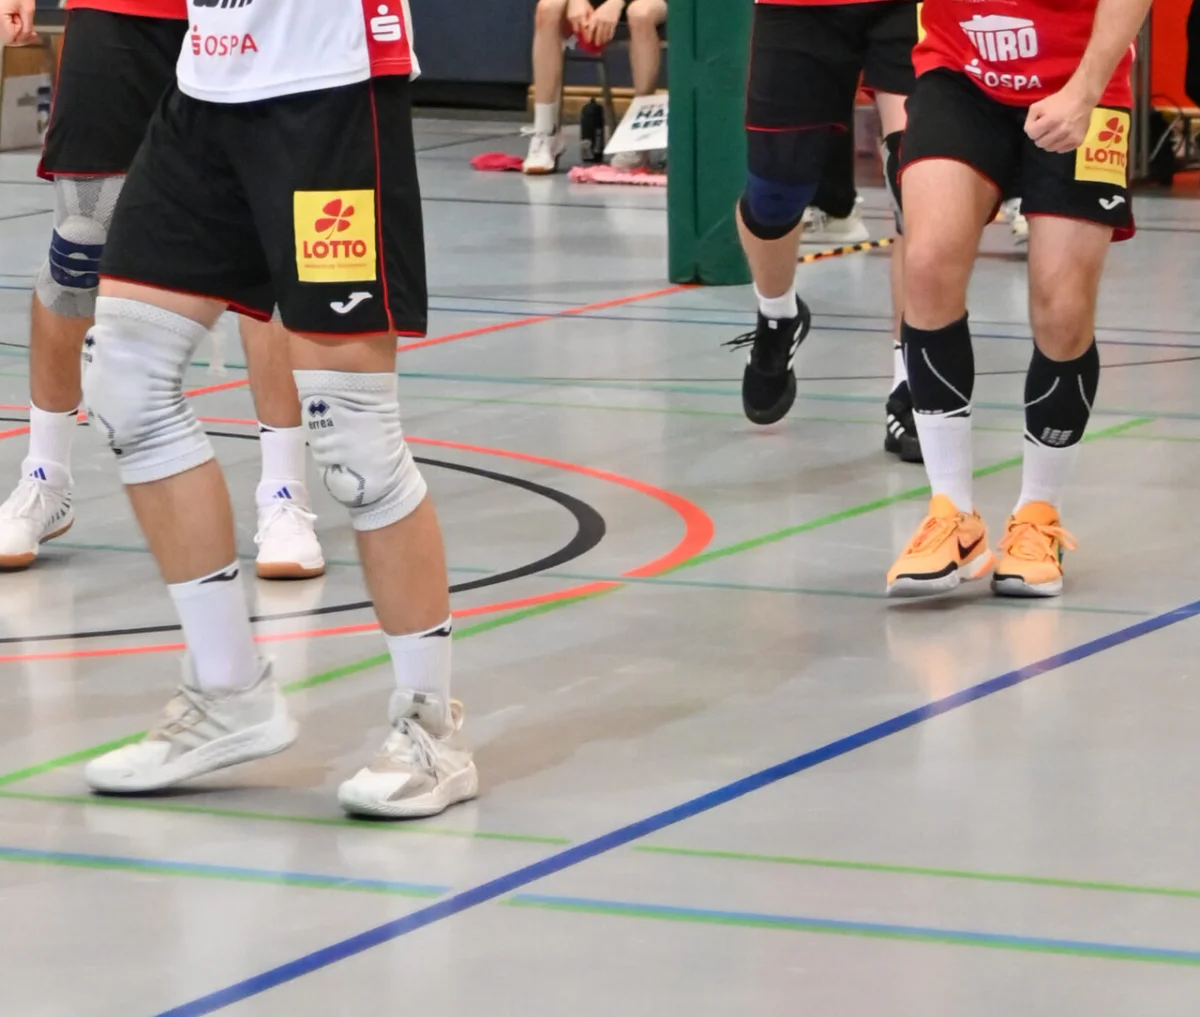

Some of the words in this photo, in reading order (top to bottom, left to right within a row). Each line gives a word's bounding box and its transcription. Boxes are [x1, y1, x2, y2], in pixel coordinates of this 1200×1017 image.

[204, 33, 259, 57] OSPA
[984, 71, 1042, 91] OSPA
[303, 239, 368, 259] LOTTO
